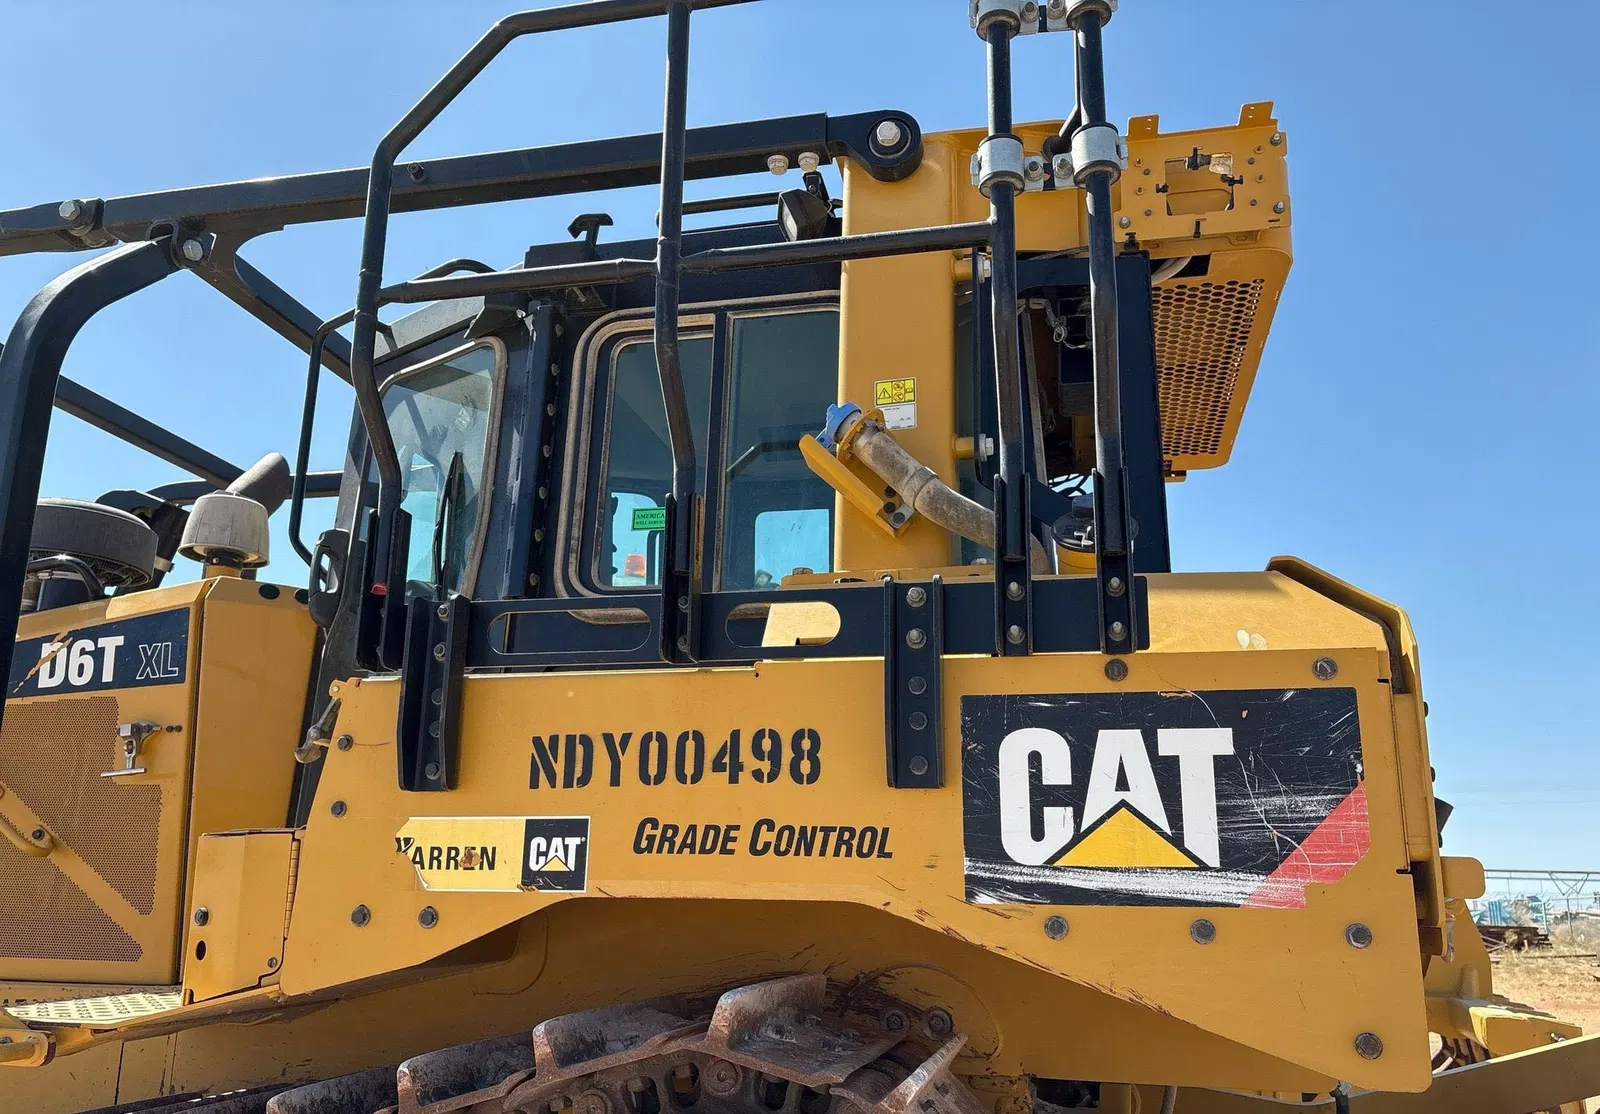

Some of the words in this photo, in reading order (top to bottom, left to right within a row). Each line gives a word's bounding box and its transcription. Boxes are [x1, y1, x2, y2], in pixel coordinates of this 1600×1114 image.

[38, 635, 124, 689] D6T
[136, 642, 179, 680] XL
[529, 728, 821, 789] NDY00498
[999, 727, 1234, 868] CAT
[529, 836, 581, 872] CAT
[633, 817, 741, 855] GRADE
[749, 818, 893, 859] CONTROL
